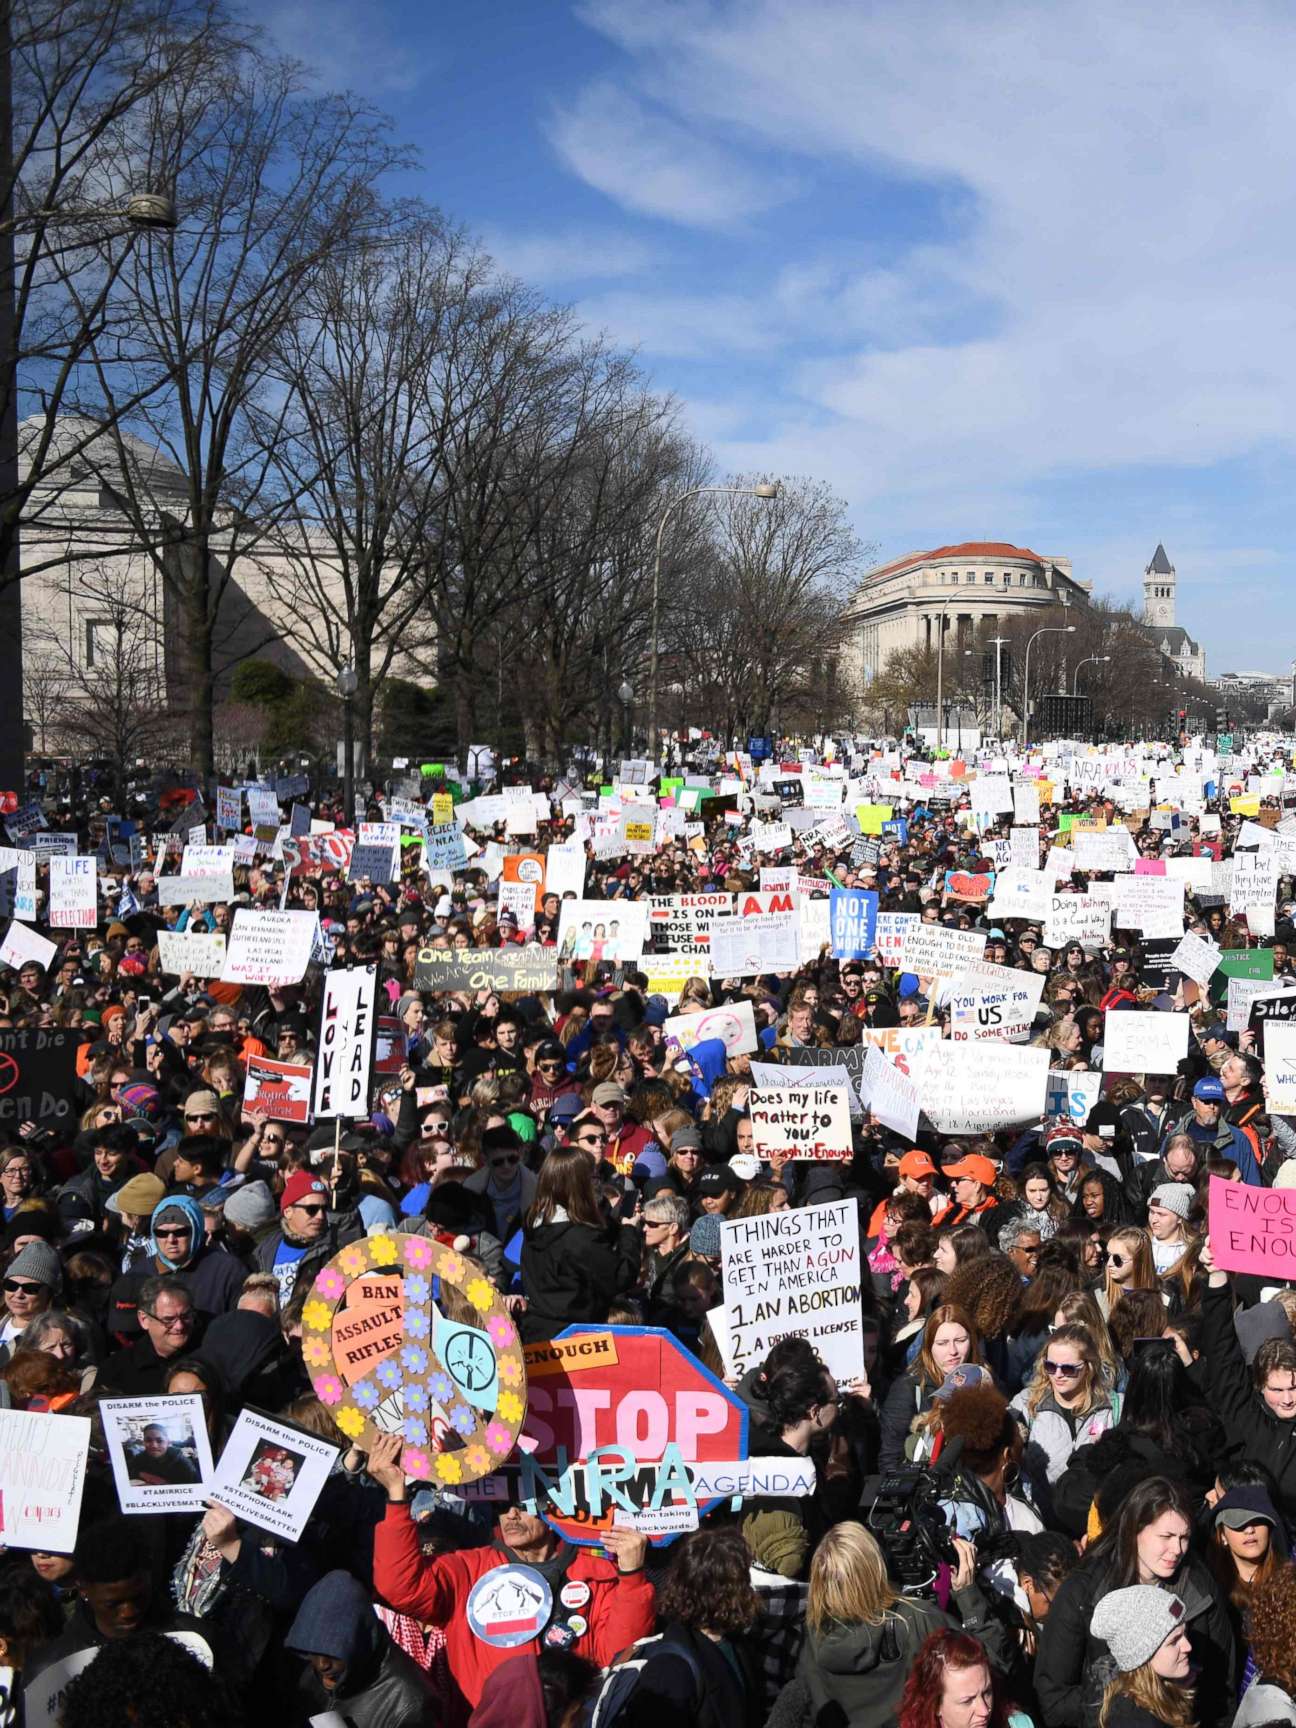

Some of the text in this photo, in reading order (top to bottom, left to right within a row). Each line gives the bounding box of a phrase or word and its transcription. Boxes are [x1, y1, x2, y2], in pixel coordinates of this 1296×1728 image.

[361, 824, 374, 832] MY
[427, 823, 456, 836] REJECT
[17, 852, 34, 866] KID
[65, 859, 89, 875] LIFE
[650, 896, 727, 907] THE BLOOD
[836, 897, 870, 917] NOT
[1052, 898, 1110, 913] Doing Nothing
[695, 909, 714, 917] ON
[1091, 915, 1105, 927] Way
[654, 923, 692, 932] THOSE
[836, 917, 869, 937] ONE
[652, 935, 693, 944] REFUSE
[907, 936, 943, 947] ENOUGH
[1082, 929, 1104, 943] Nothing
[418, 948, 493, 963] One Team
[469, 970, 556, 990] One Family
[954, 992, 1028, 1008] YOU WORK FOR
[979, 1006, 1002, 1025] US
[955, 1031, 968, 1040] DO
[1126, 1034, 1171, 1050] EMMA
[321, 992, 337, 1111] LOVE
[351, 987, 368, 1101] LEAD
[750, 1090, 838, 1108] Does my life
[753, 1111, 831, 1127] matter to
[785, 1126, 819, 1140] you?
[805, 1143, 854, 1160] is Enough
[727, 1206, 850, 1244] THINGS THAT
[1261, 1218, 1294, 1234] IS
[728, 1234, 842, 1267] ARE HARDER TO
[728, 1246, 855, 1285] GET THAN A GUN
[745, 1268, 838, 1296] IN AMERICA
[362, 1286, 399, 1298] BAN
[730, 1283, 862, 1330] 1. AN ABORTION
[335, 1306, 404, 1342] ASSAULT
[732, 1320, 858, 1360] 2. A LICENSE
[346, 1333, 403, 1364] RIFLES
[525, 1340, 610, 1364] ENOUGH
[106, 1398, 197, 1410] DISARM the POLICE
[518, 1386, 728, 1461] STOP
[245, 1416, 331, 1458] DISARM the POLICE
[519, 1442, 698, 1517] NRA
[694, 1475, 810, 1494] AGENDA
[143, 1487, 194, 1496] #TAMIRRICE
[223, 1485, 295, 1519] #STEPHONCLARK
[209, 1491, 299, 1534] #BLACKLIVESMATTER
[633, 1509, 691, 1521] from taking
